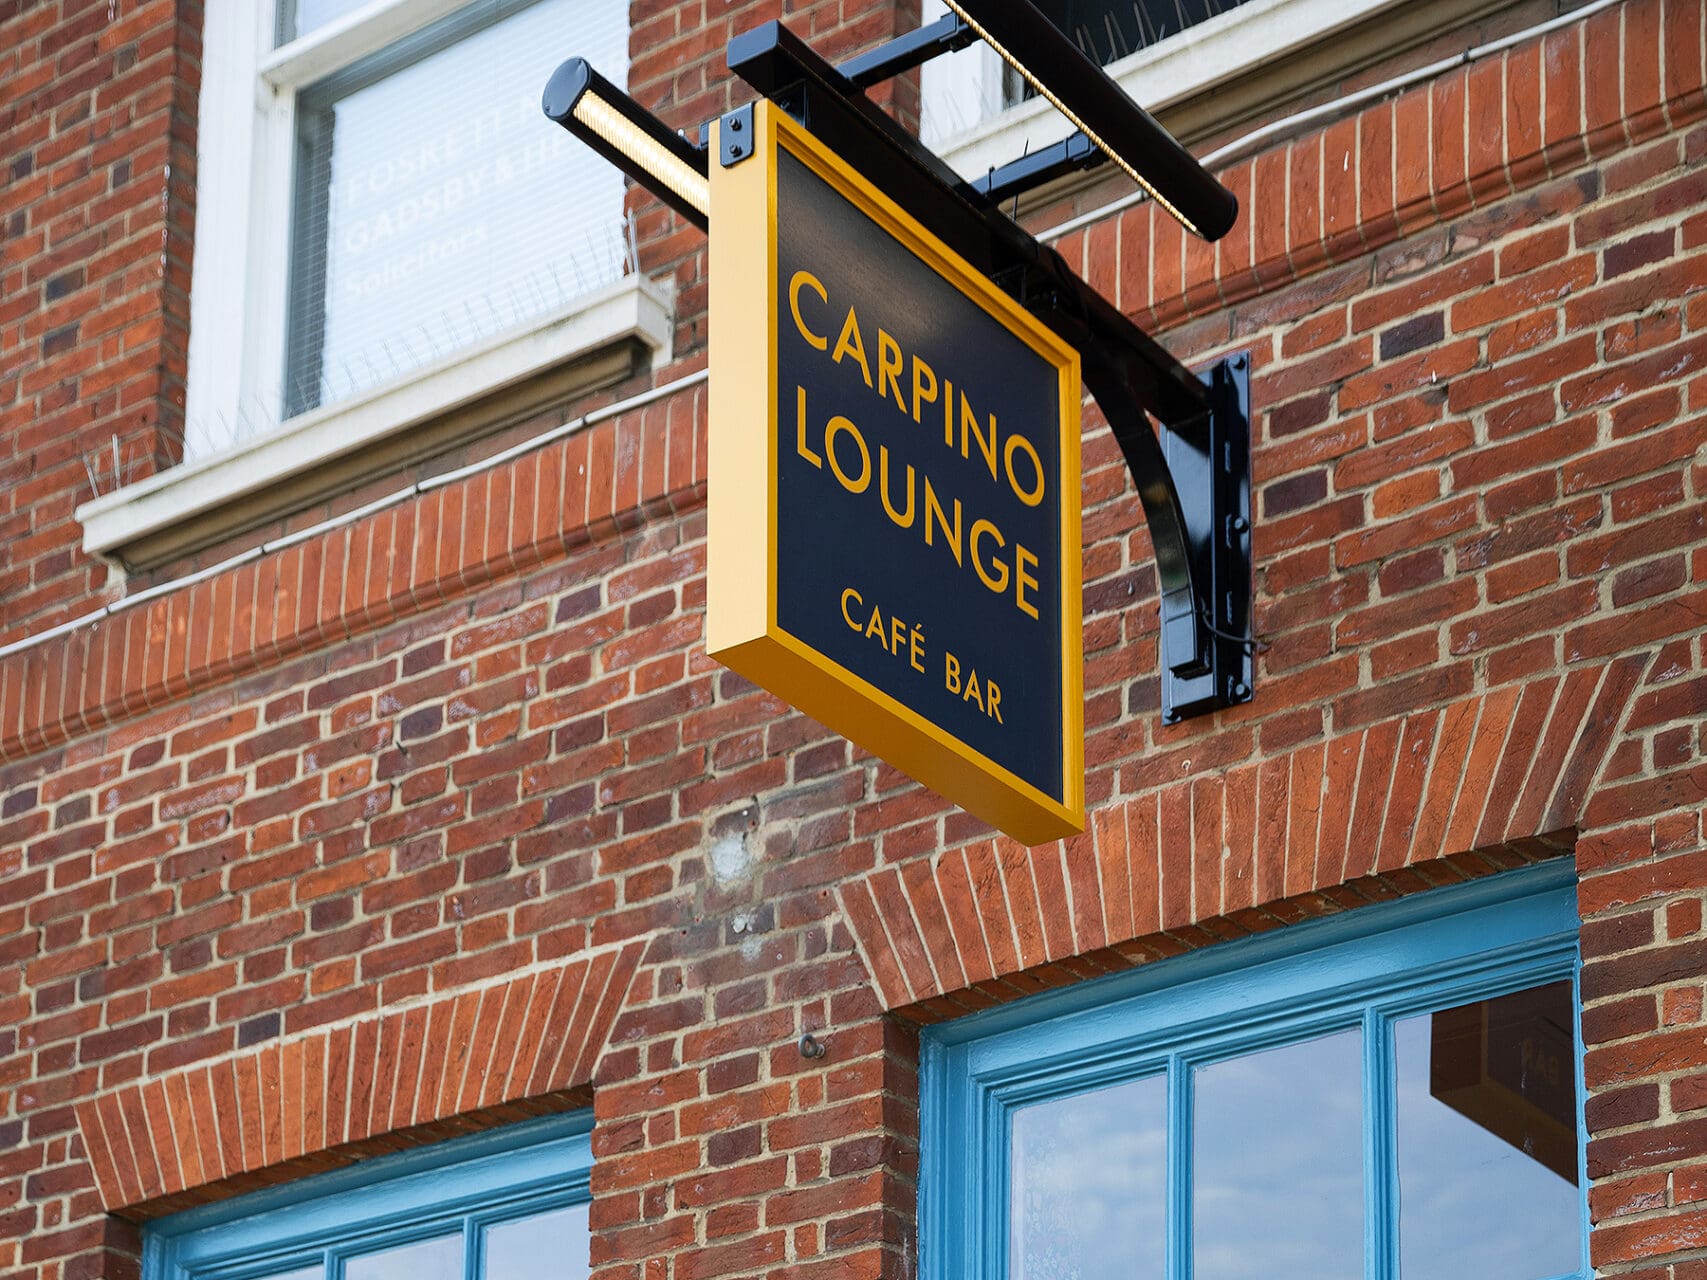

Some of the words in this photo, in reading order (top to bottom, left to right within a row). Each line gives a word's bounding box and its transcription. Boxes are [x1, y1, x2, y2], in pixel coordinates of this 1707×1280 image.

[789, 270, 1045, 507] CARPINO
[797, 385, 1039, 621] LOUNGE
[841, 587, 926, 674] CAFÉ
[945, 651, 1004, 725] BAR
